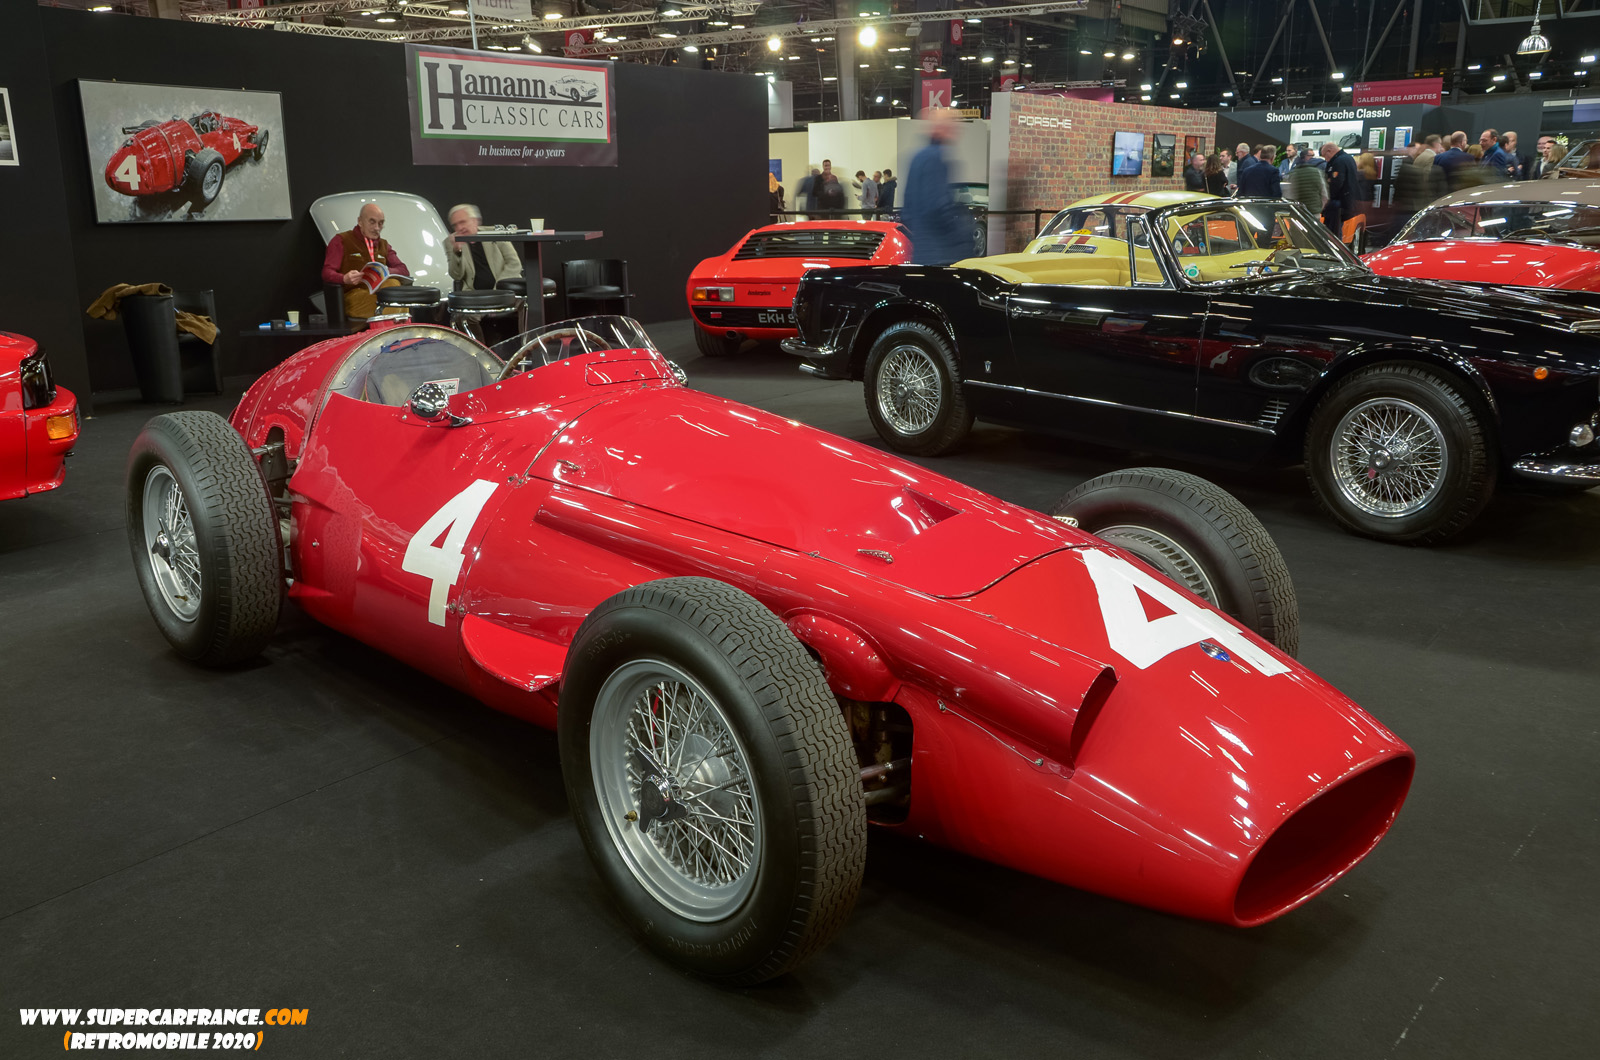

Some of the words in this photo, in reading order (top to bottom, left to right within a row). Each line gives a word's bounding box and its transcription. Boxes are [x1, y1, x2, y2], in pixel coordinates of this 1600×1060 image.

[423, 62, 548, 131] Hamann
[928, 89, 945, 111] K
[1356, 95, 1387, 104] GALERIE
[1387, 94, 1402, 103] DES
[1402, 92, 1437, 102] ARTISTES
[466, 104, 549, 126] CLASSIC
[558, 109, 604, 129] CARS
[1018, 115, 1072, 129] PORSCHE
[1266, 111, 1315, 122] Showroom
[1316, 108, 1355, 120] Porsche
[1356, 107, 1391, 119] Classic
[478, 145, 488, 156] In
[489, 145, 521, 157] business
[521, 146, 533, 159] for
[534, 148, 545, 159] 40
[545, 149, 566, 159] years
[114, 154, 142, 191] 4
[758, 313, 785, 324] EKH
[401, 478, 500, 627] 4
[1081, 549, 1293, 677] 4
